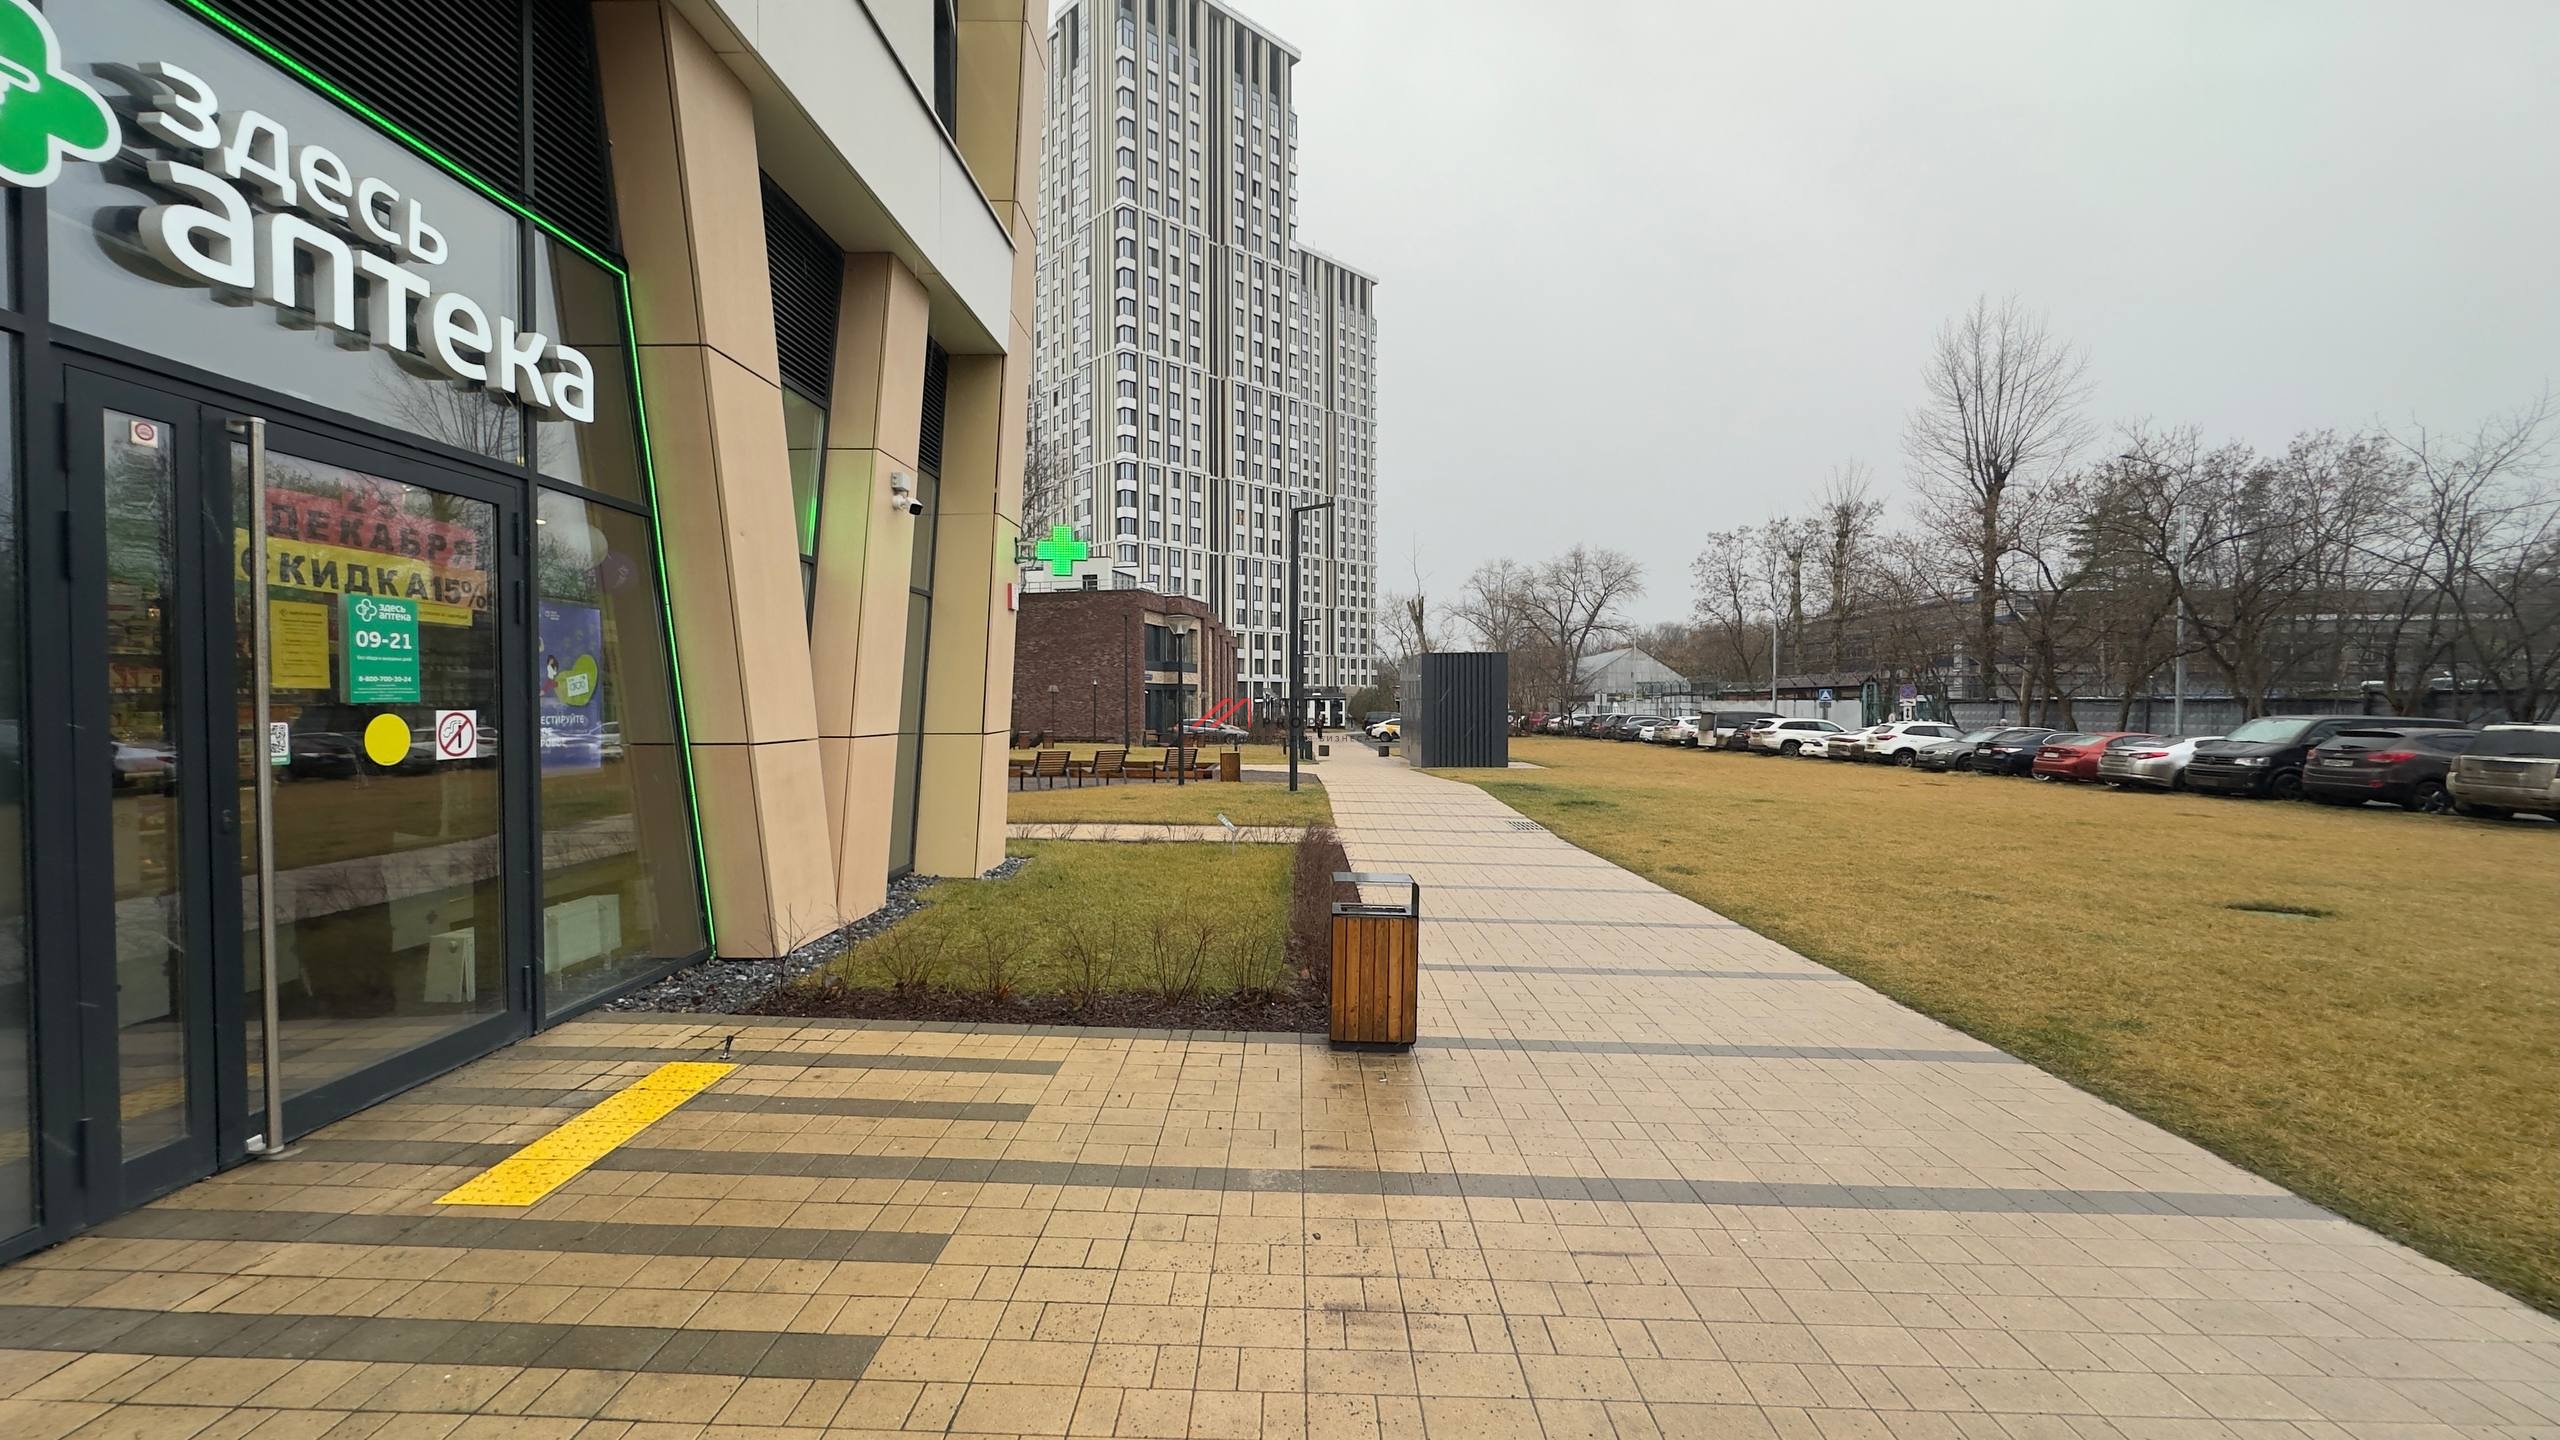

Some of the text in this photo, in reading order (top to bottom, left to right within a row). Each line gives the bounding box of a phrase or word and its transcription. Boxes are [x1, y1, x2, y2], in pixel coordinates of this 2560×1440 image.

[140, 161, 595, 424] аптека
[267, 503, 474, 564] ДЕКАБРЯ
[430, 575, 487, 609] 15%
[379, 612, 412, 621] аптека
[355, 630, 412, 650] 09-21
